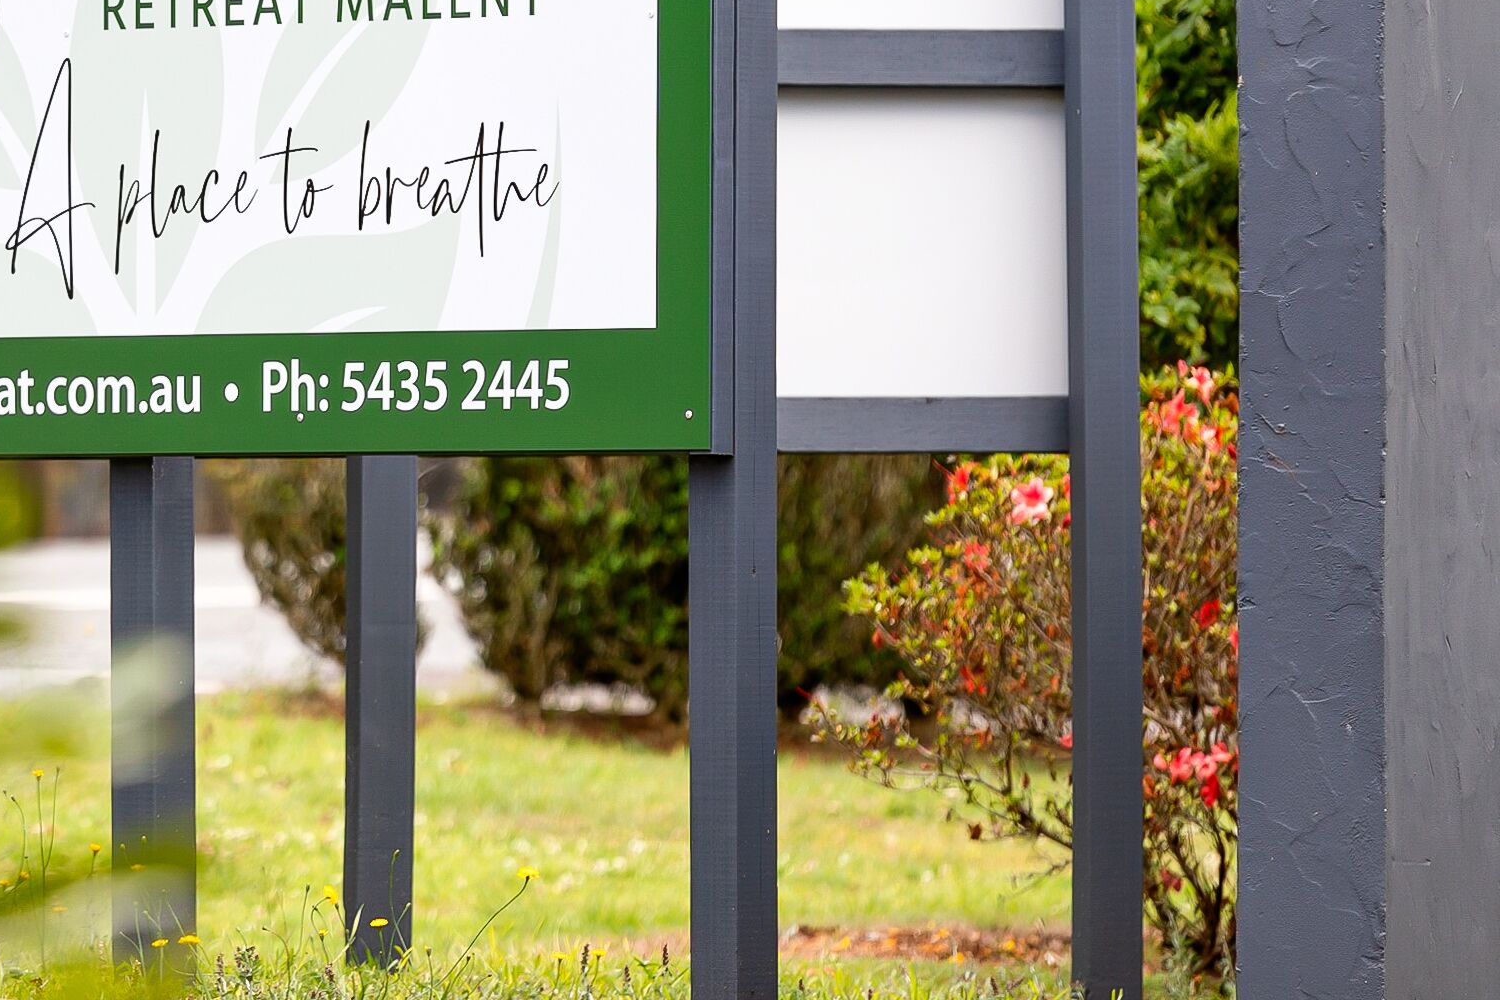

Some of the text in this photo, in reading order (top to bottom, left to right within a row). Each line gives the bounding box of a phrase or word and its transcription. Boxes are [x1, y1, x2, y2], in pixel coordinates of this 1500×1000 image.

[5, 57, 560, 300] A place to breathe
[261, 359, 329, 413] Ph:
[341, 360, 449, 414] 5435
[460, 359, 572, 413] 2445
